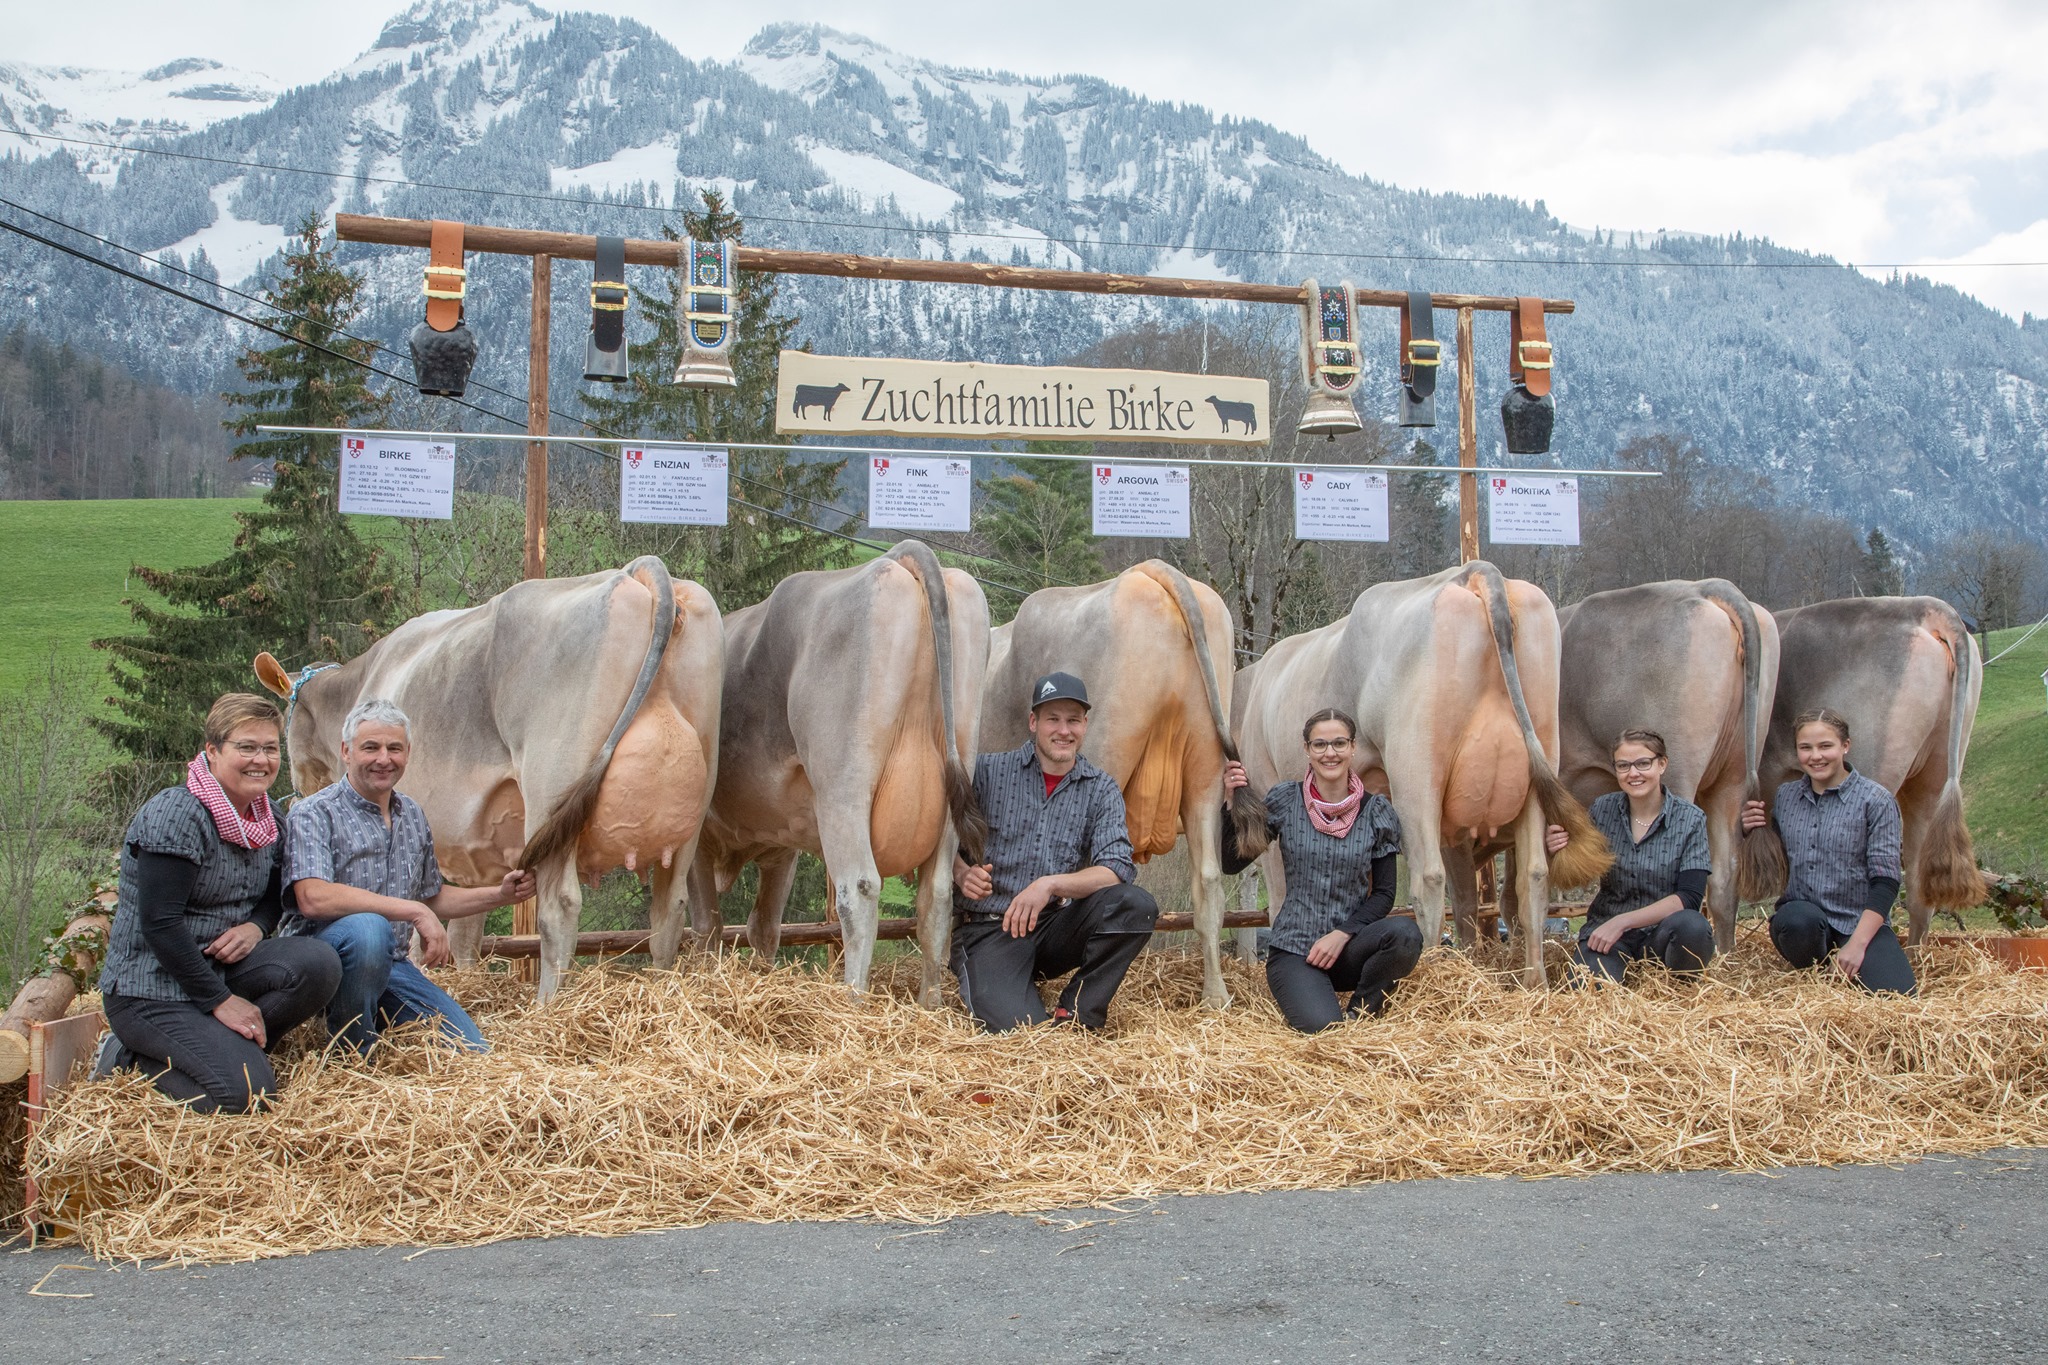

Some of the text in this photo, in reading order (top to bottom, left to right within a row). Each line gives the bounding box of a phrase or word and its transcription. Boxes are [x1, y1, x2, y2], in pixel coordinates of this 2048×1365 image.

[860, 377, 1195, 432] Zuchtfamilie Birke
[379, 450, 412, 461] BIRKE
[654, 460, 690, 469] ENZIAN
[906, 468, 928, 477] FINK
[1117, 476, 1159, 485] ARGOVIA
[1327, 482, 1352, 490] CADY
[1511, 487, 1551, 496] HOKITIKA
